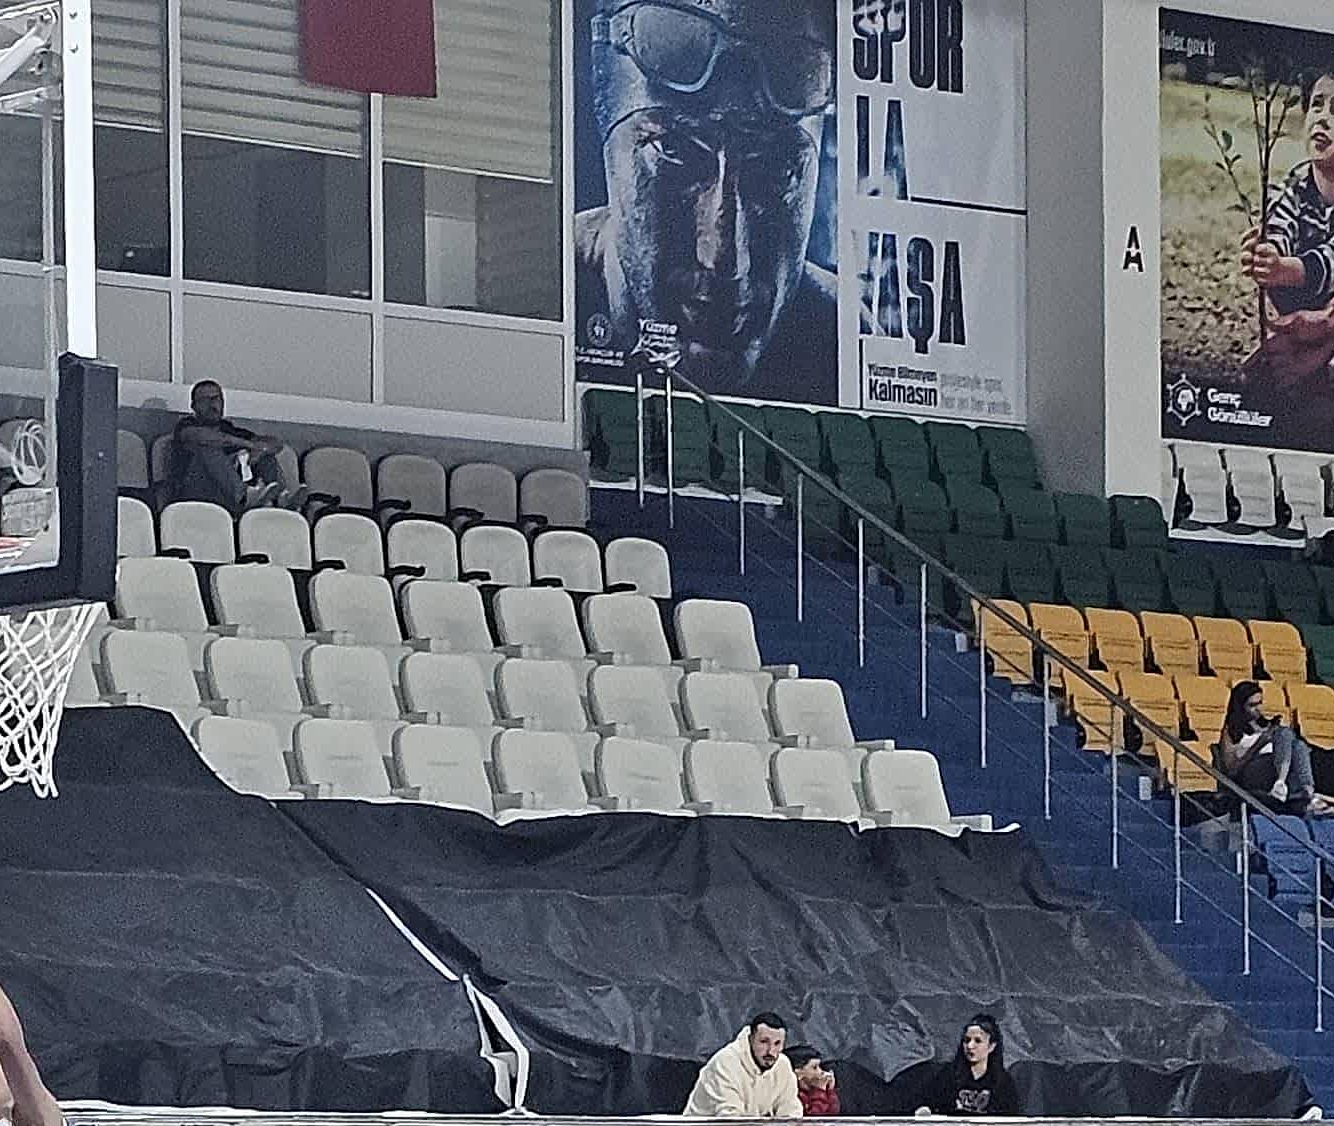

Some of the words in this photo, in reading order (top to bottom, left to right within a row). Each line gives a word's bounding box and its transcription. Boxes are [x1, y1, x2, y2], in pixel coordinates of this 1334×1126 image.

[852, 0, 964, 94] SPOR
[856, 95, 909, 200] LA
[1123, 226, 1144, 273] A
[869, 377, 938, 408] Kalmasın
